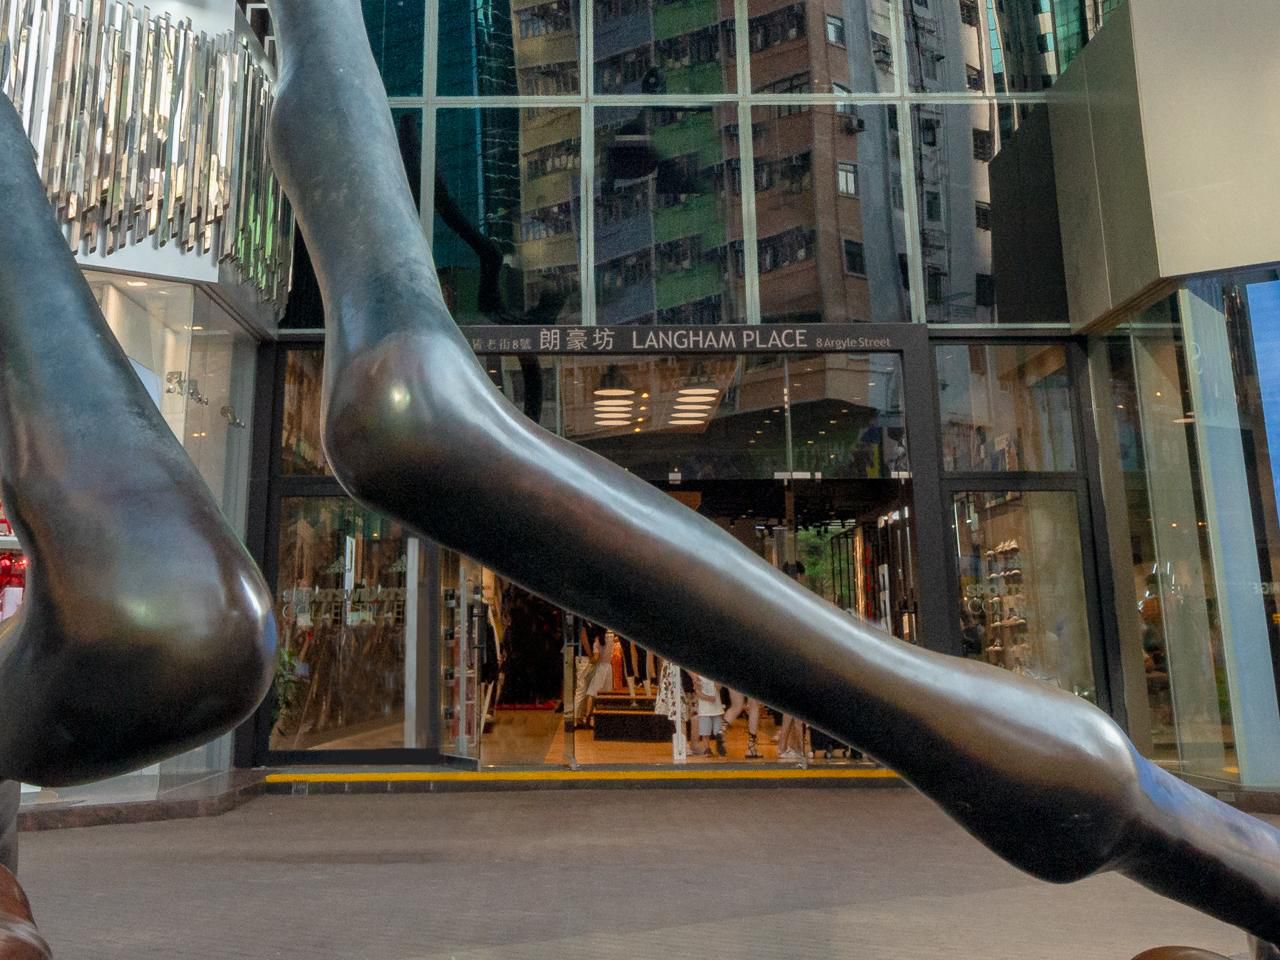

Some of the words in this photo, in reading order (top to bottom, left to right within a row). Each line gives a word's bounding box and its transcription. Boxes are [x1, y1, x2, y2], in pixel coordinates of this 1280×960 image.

[539, 327, 616, 351] 朗豪坊
[632, 330, 737, 349] LANGHAM
[742, 329, 808, 349] PLACE
[816, 337, 823, 348] 8
[824, 337, 856, 350] Argyle
[858, 336, 891, 349] Street
